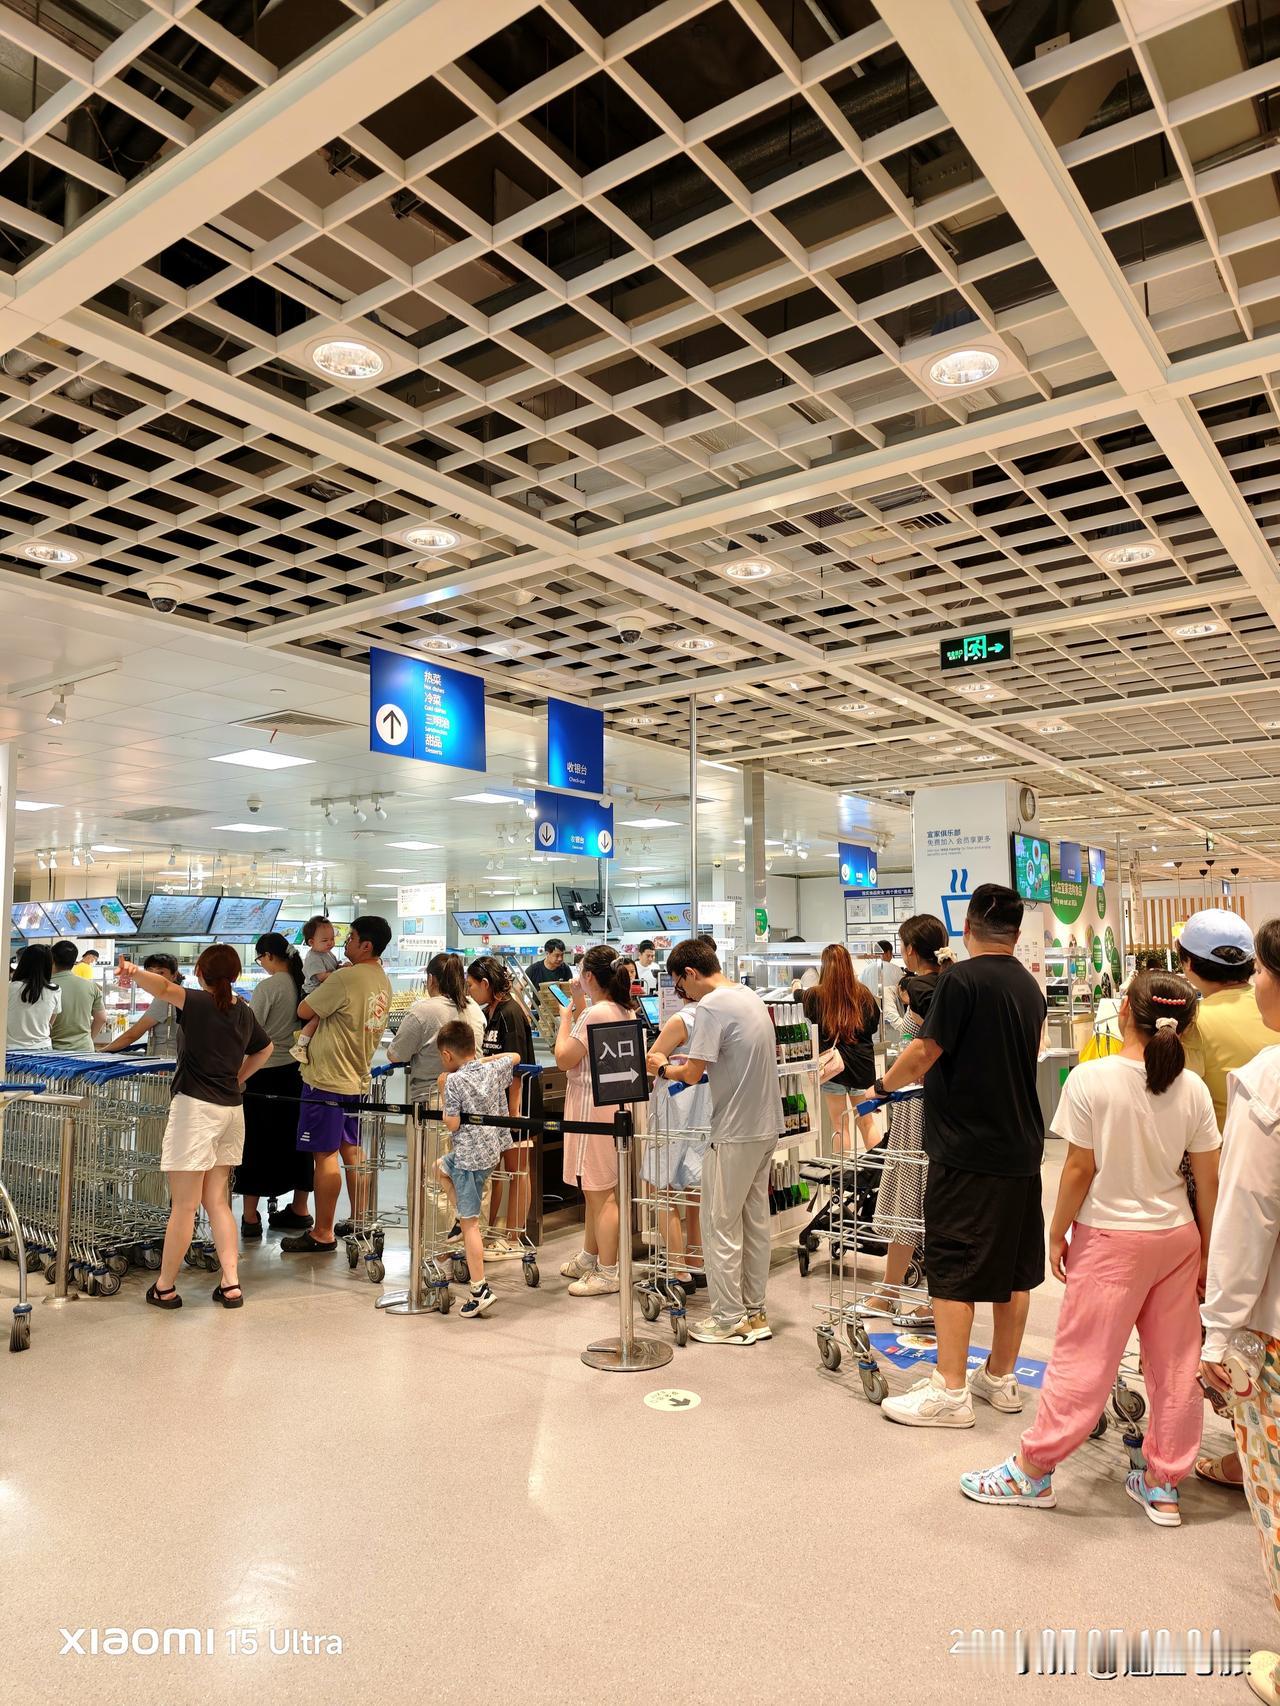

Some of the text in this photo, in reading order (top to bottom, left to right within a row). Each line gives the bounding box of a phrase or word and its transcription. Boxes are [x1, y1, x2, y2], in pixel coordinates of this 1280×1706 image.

[424, 672, 441, 686] 热菜
[424, 693, 441, 707] 冷菜
[426, 734, 442, 748] 甜品
[567, 762, 588, 776] 收银台
[927, 829, 961, 838] 宜家俱乐部
[599, 1040, 635, 1060] 入口
